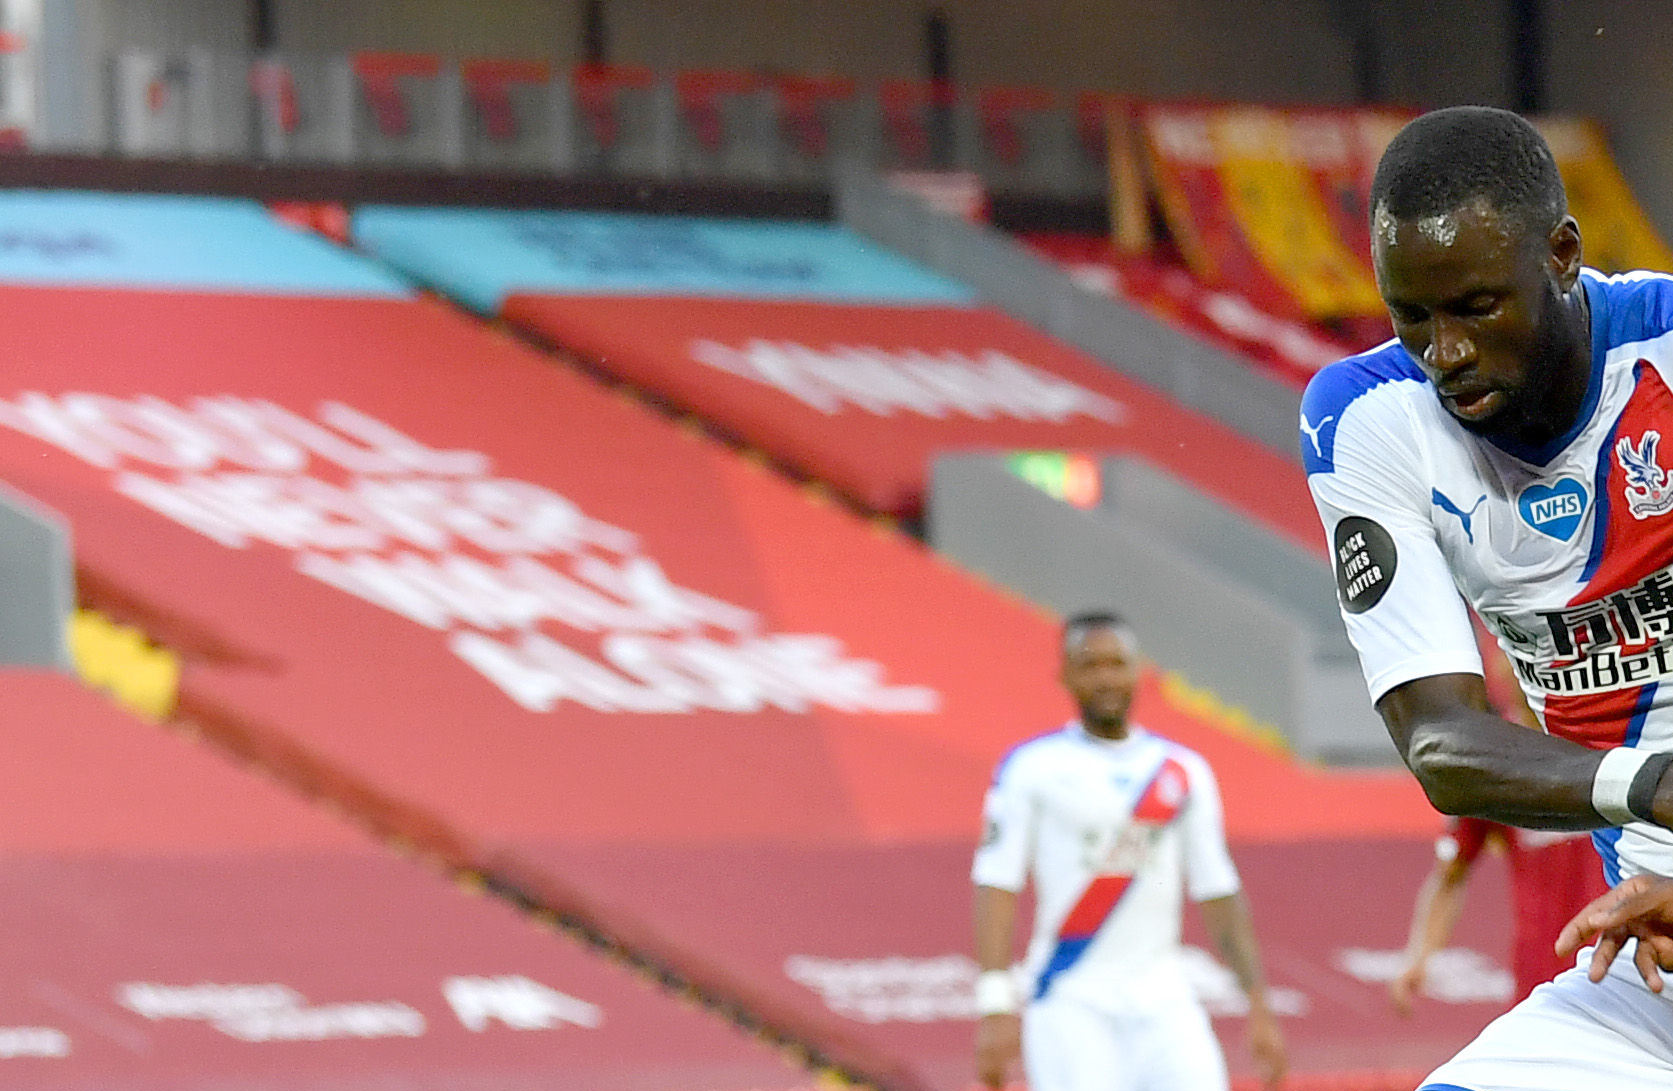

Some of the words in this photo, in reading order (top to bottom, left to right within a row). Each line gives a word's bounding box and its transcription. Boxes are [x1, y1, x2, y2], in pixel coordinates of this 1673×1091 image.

[1535, 495, 1578, 521] NHS
[1344, 551, 1370, 580] LIVES
[1346, 565, 1383, 601] MATTER
